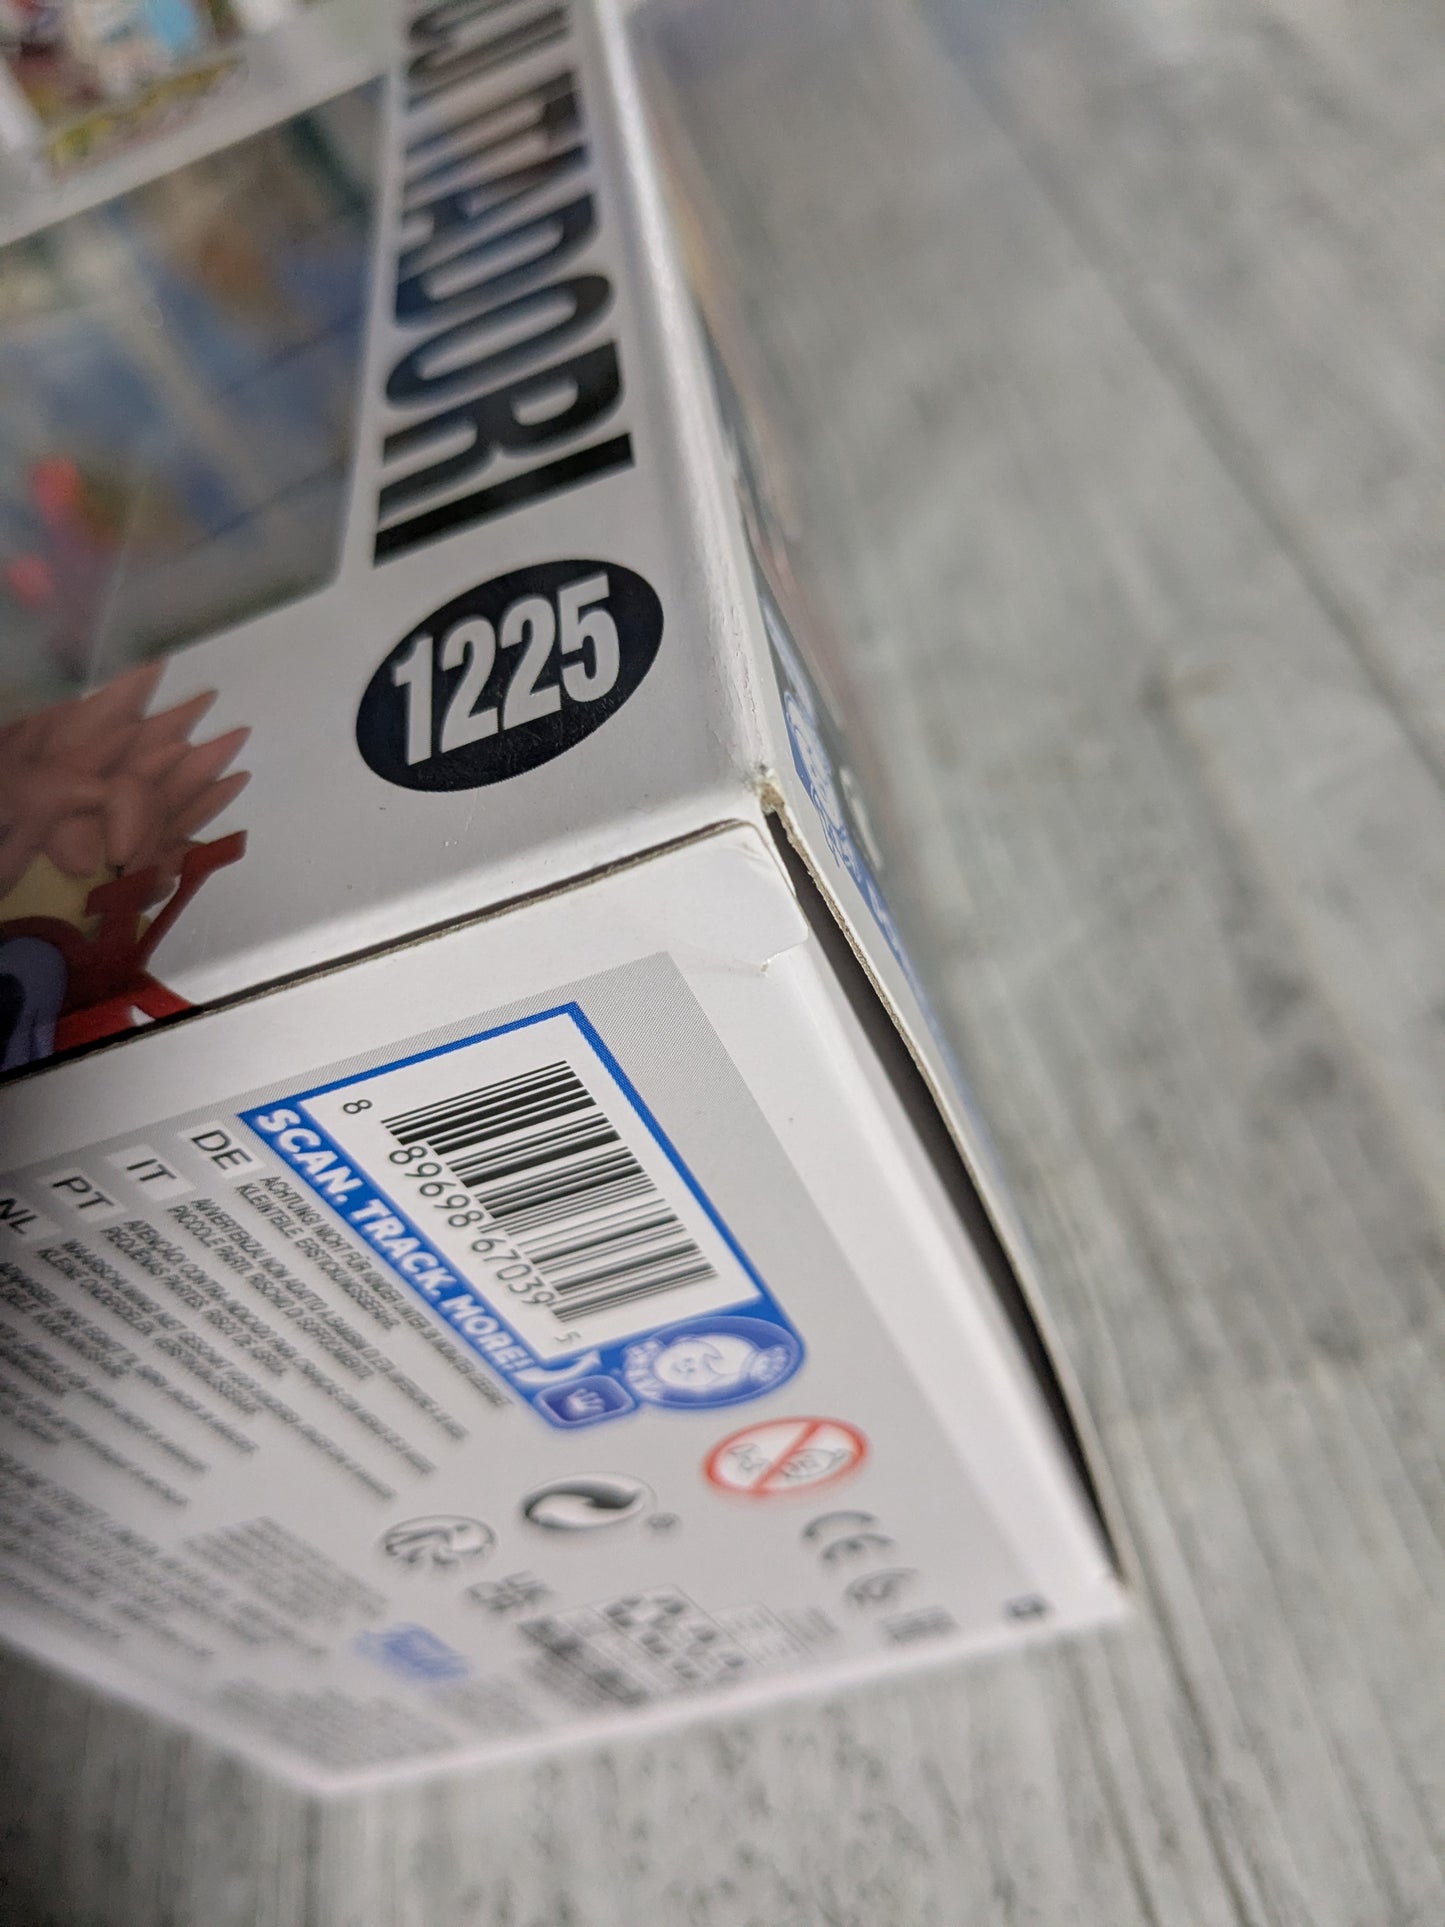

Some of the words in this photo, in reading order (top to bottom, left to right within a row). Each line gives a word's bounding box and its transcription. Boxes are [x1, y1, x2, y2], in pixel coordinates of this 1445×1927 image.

[372, 68, 636, 567] ITADORI
[393, 571, 619, 766] 1225
[344, 1099, 372, 1114] 8
[189, 1128, 252, 1170] DE
[50, 1174, 114, 1214] PT
[124, 1157, 177, 1188] IT
[388, 1144, 485, 1228] 89698
[0, 1198, 46, 1233] NL
[167, 1204, 226, 1247] PICCOLE
[258, 1173, 324, 1226] ACHTUNG!
[309, 1222, 354, 1254] NICHT
[256, 1108, 365, 1203] SCAN.
[350, 1201, 456, 1295] TRACK.
[440, 1295, 531, 1371] MORE!
[256, 1256, 293, 1279] NON
[470, 1237, 556, 1306] 67039
